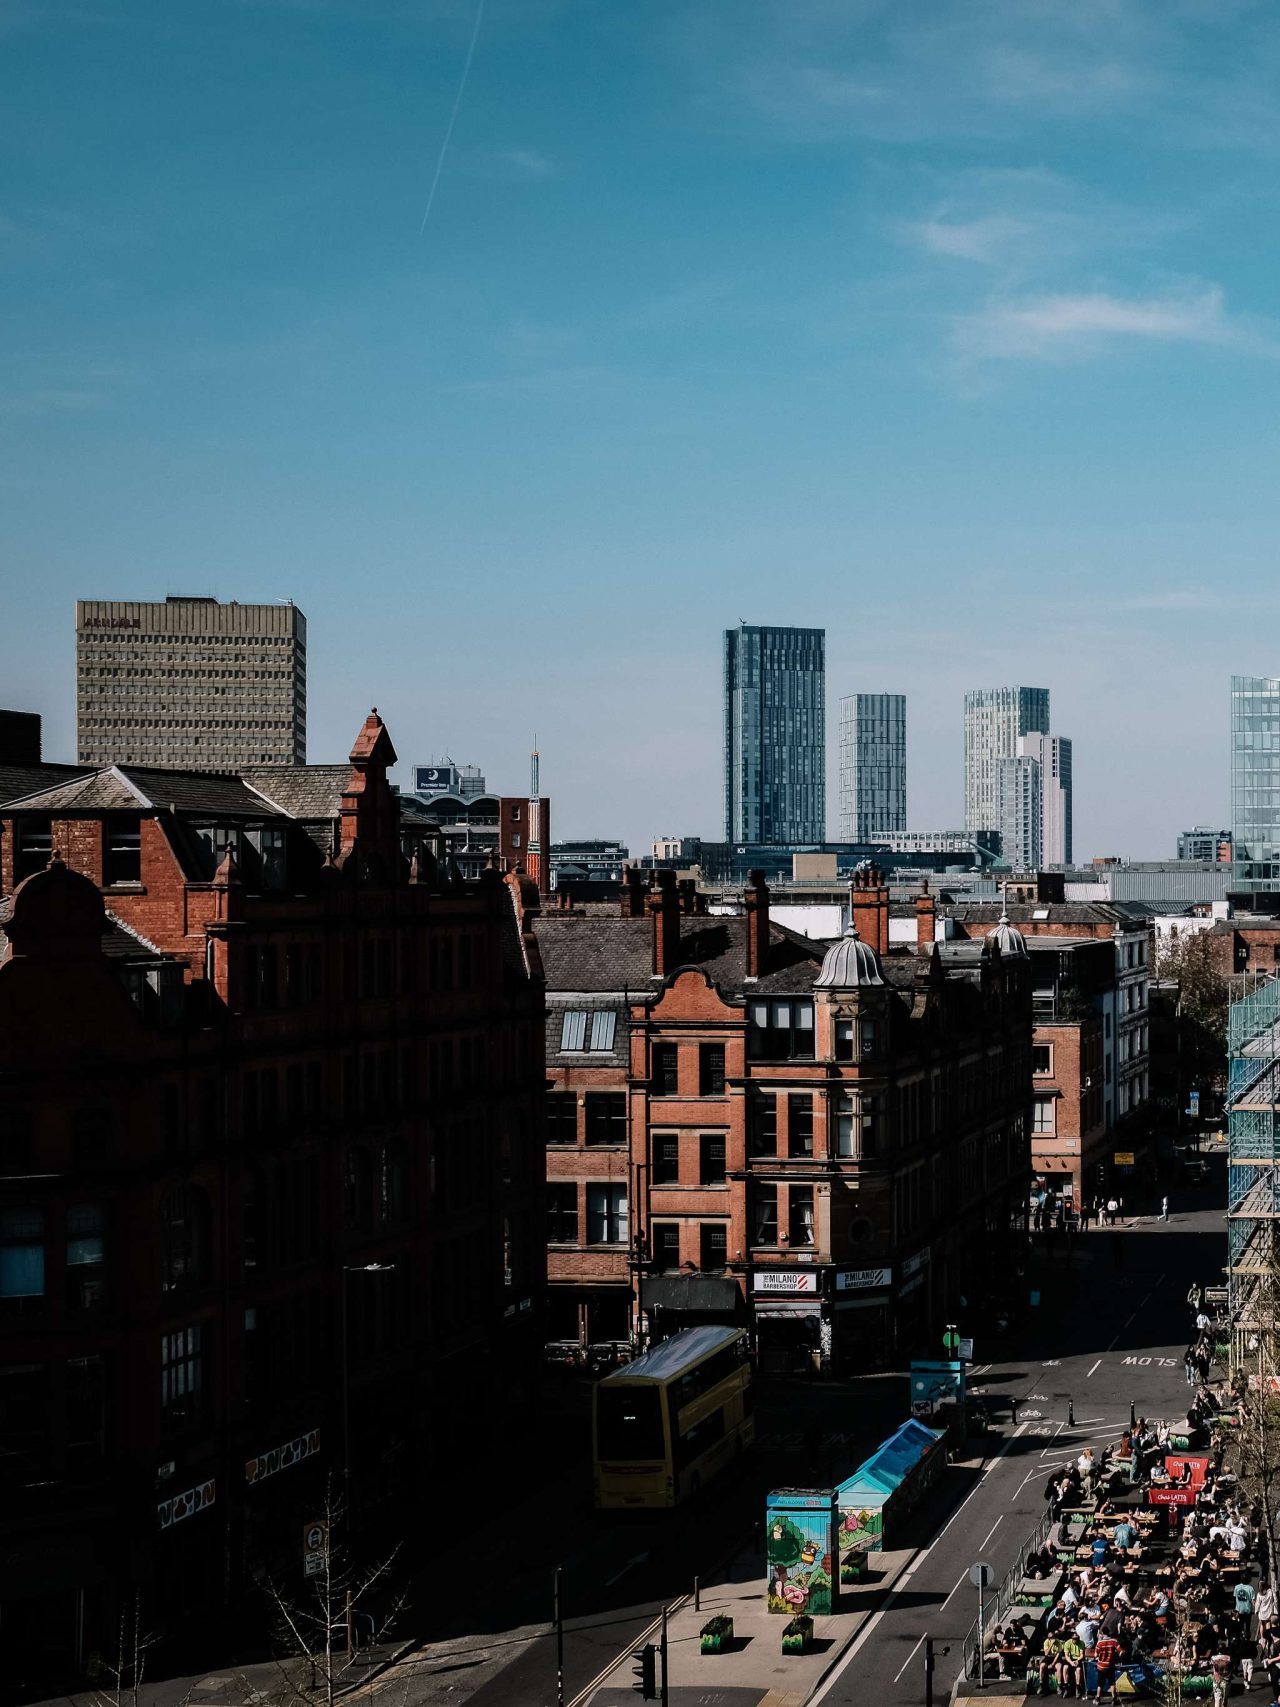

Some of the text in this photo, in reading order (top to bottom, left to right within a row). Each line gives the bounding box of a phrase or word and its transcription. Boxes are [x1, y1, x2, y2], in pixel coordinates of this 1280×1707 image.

[769, 1275, 798, 1283] MILANO
[849, 1271, 875, 1281] MILANO
[1121, 1357, 1178, 1367] SLOW
